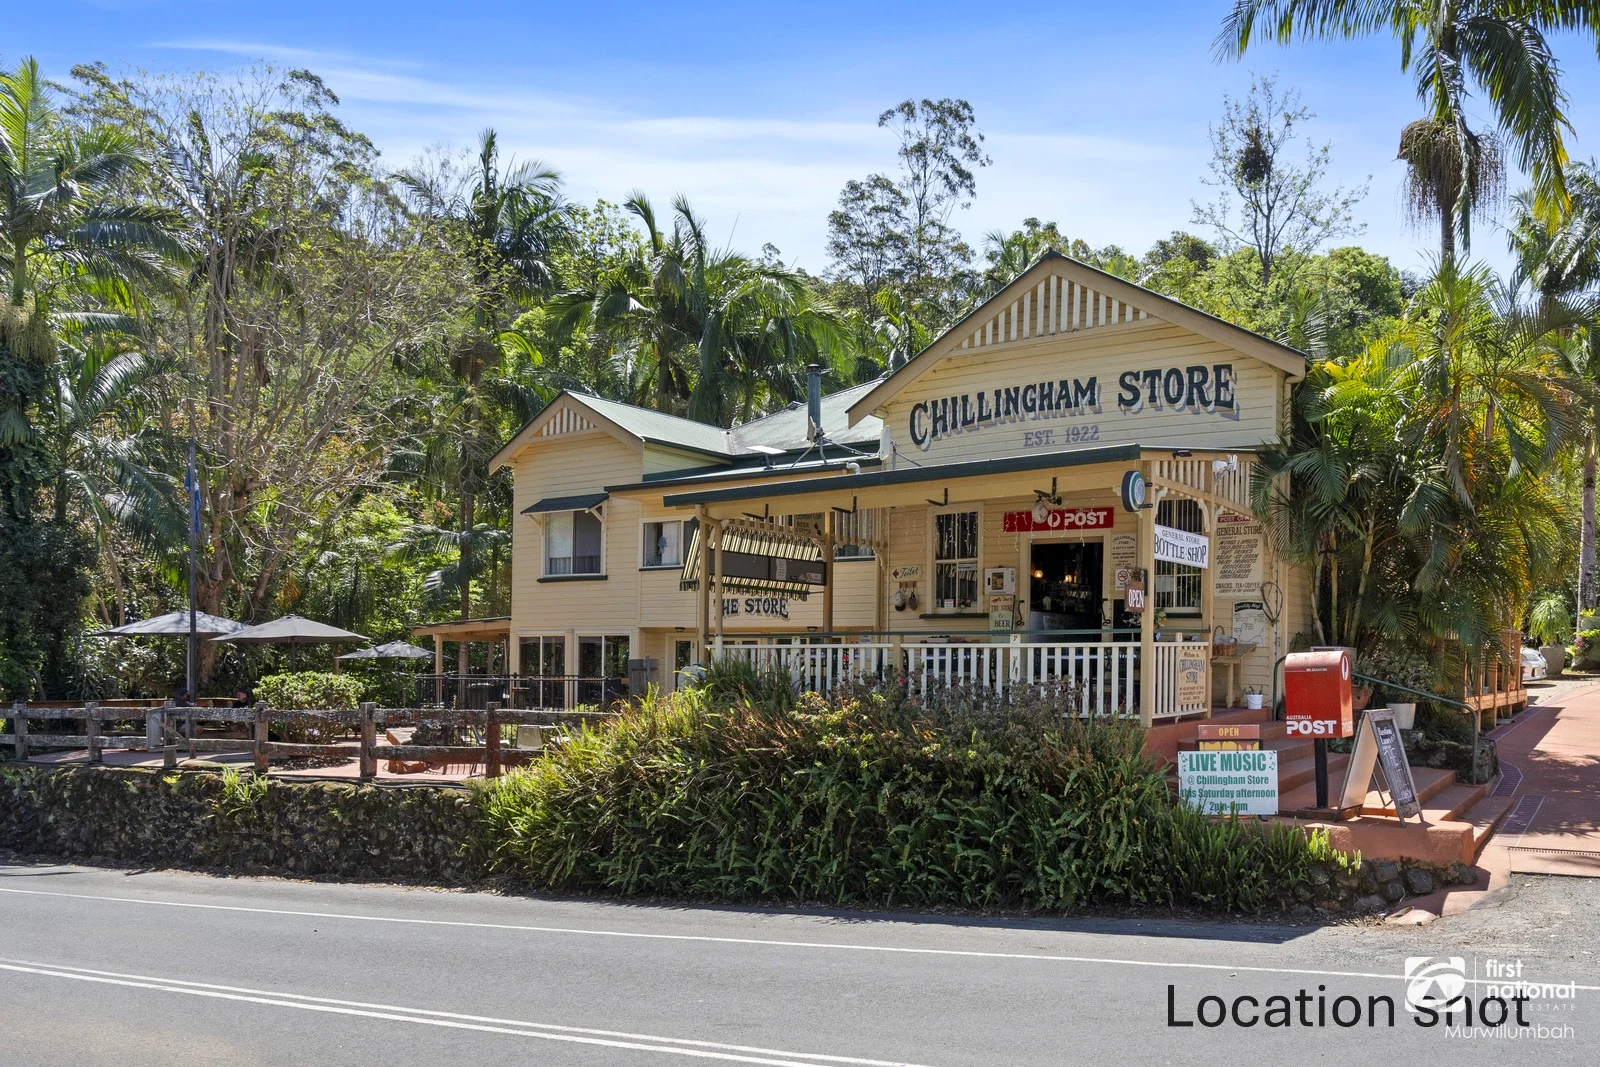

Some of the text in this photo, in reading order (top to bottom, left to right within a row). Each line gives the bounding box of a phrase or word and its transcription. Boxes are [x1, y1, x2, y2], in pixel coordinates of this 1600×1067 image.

[910, 364, 1237, 449] CHILLINGHAM STORE
[1023, 424, 1100, 447] EST. 1922
[1065, 511, 1107, 526] POST
[1161, 529, 1200, 545] GENERAL STORE
[1216, 525, 1262, 536] GENERAL STORE
[1154, 533, 1207, 564] BOTTLE SHOP
[900, 567, 919, 578] Toilet
[1128, 588, 1143, 607] OPEN
[745, 598, 790, 619] STORE
[1218, 727, 1240, 737] OPEN
[1286, 720, 1337, 735] POST
[1188, 753, 1267, 772] LIVE MUSIC
[1187, 775, 1269, 785] @ Chillingham Store
[1198, 788, 1234, 798] Saturday
[1236, 788, 1276, 798] afternoon
